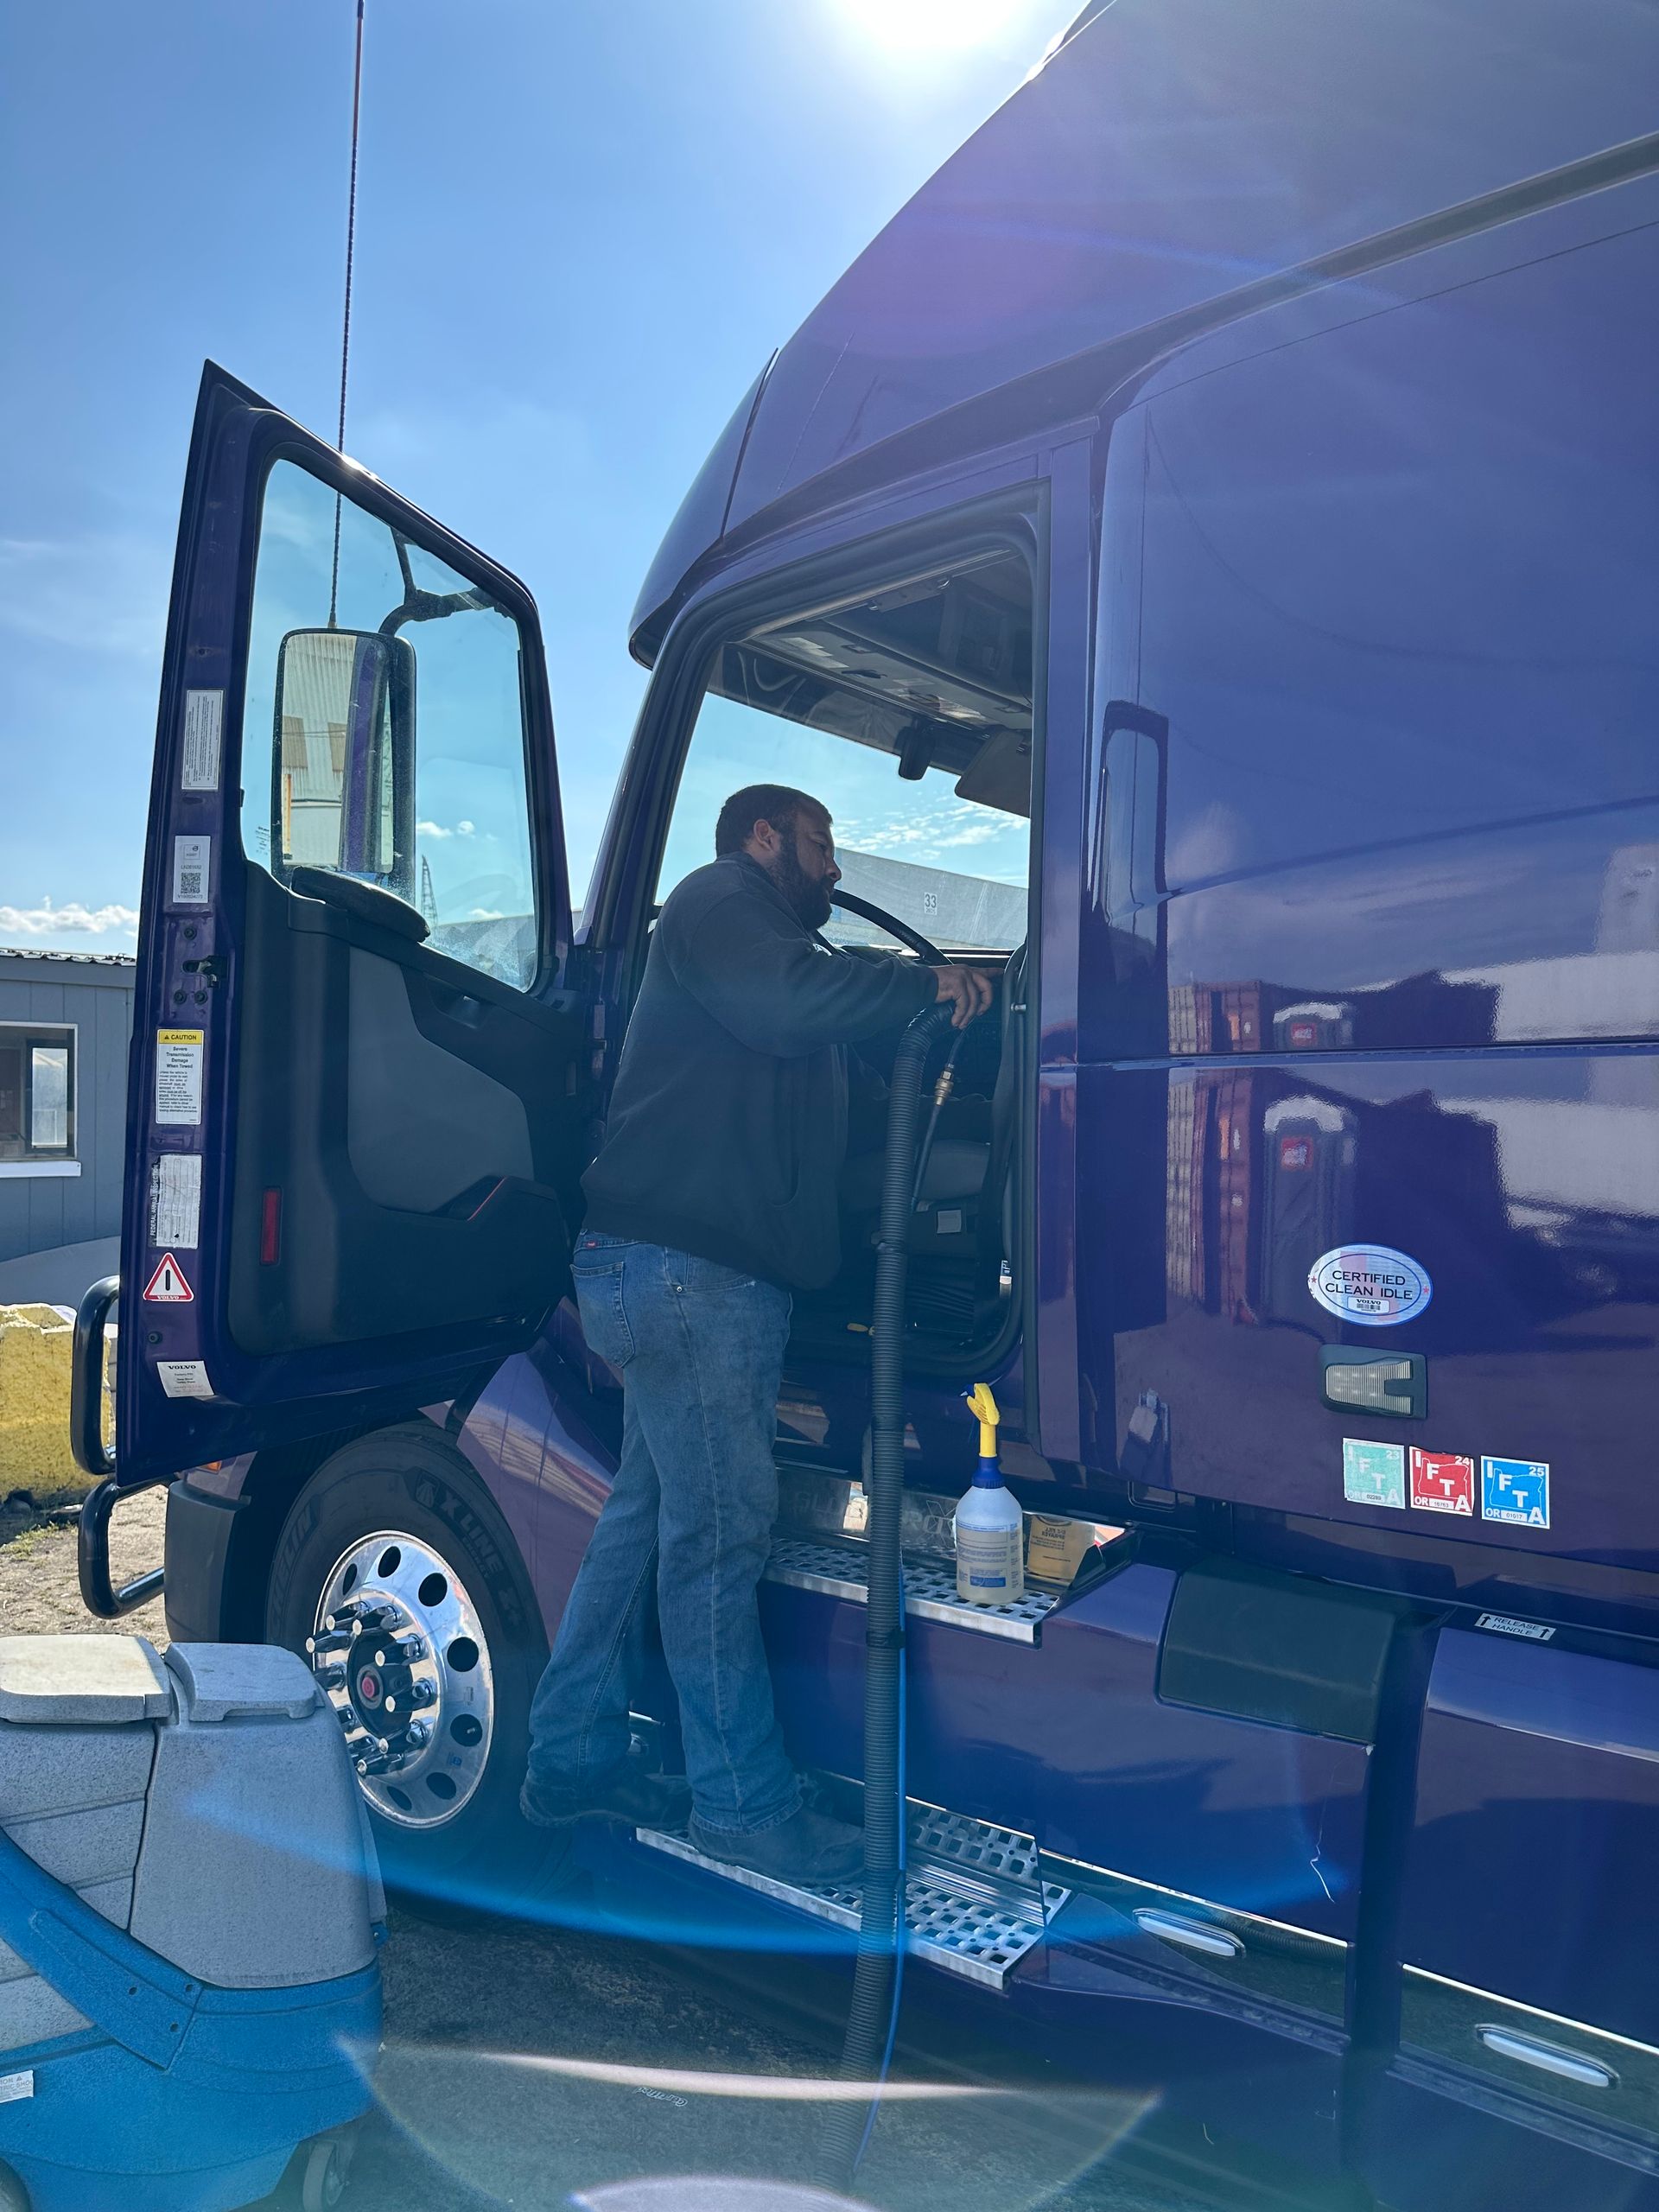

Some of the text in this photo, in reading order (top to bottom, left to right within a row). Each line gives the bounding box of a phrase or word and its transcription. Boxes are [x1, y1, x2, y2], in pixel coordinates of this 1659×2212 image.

[925, 893, 937, 908] 33
[1332, 1270, 1405, 1286] CERTIFIED
[1325, 1283, 1413, 1300] CLEAN IDLE
[1386, 1450, 1400, 1460] 23
[1455, 1455, 1470, 1465] 24
[1529, 1466, 1544, 1477] 25
[1414, 1496, 1428, 1506] OR
[1486, 1508, 1500, 1517] OR
[440, 1491, 461, 1519] X
[461, 1515, 505, 1576] LINE
[1491, 1624, 1533, 1635] HANDLE
[1494, 1618, 1540, 1630] RELEASE
